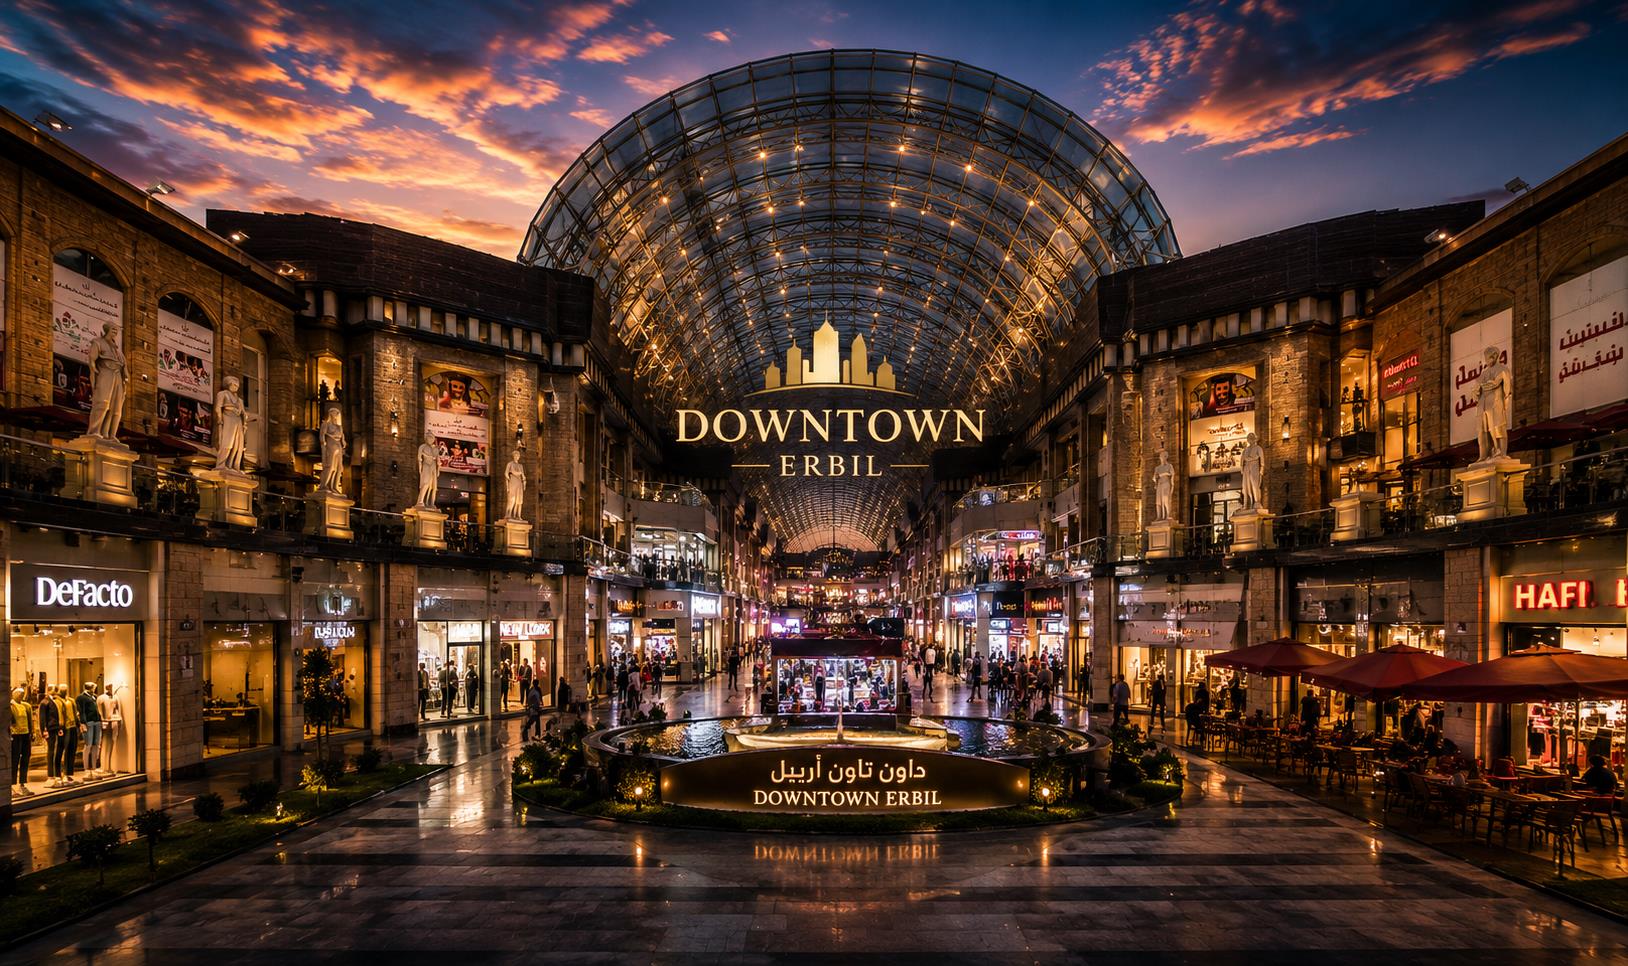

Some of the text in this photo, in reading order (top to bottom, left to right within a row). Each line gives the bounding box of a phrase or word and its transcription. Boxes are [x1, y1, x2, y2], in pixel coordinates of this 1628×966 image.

[36, 576, 134, 608] DeFacto
[1515, 580, 1588, 609] HAFI
[828, 758, 874, 784] تاون
[879, 758, 926, 784] داون
[753, 790, 942, 806] DOWNTOWN ERBIL
